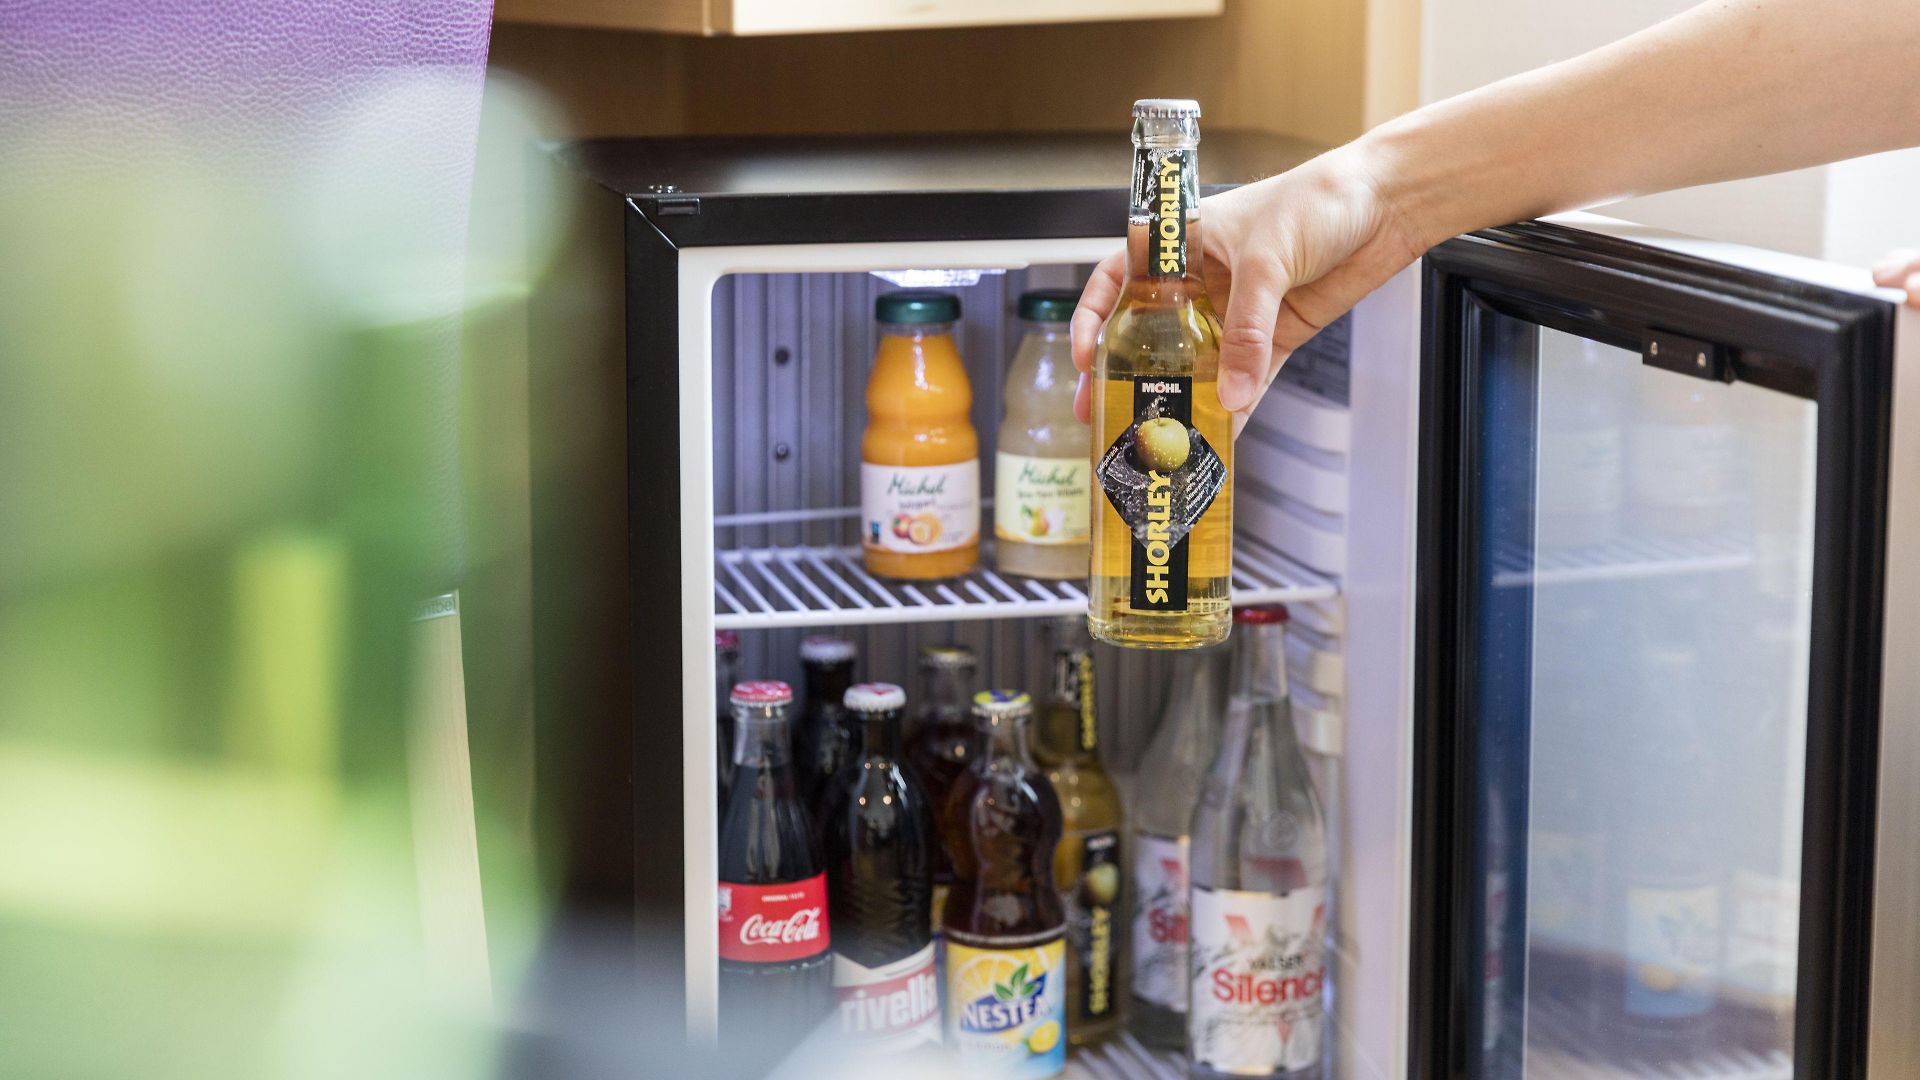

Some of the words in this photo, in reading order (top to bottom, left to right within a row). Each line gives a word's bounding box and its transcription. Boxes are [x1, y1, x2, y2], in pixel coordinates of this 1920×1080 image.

[1160, 156, 1180, 273] SHORLEY
[1141, 381, 1182, 394] MÖHL
[1146, 470, 1171, 604] SHORLEY
